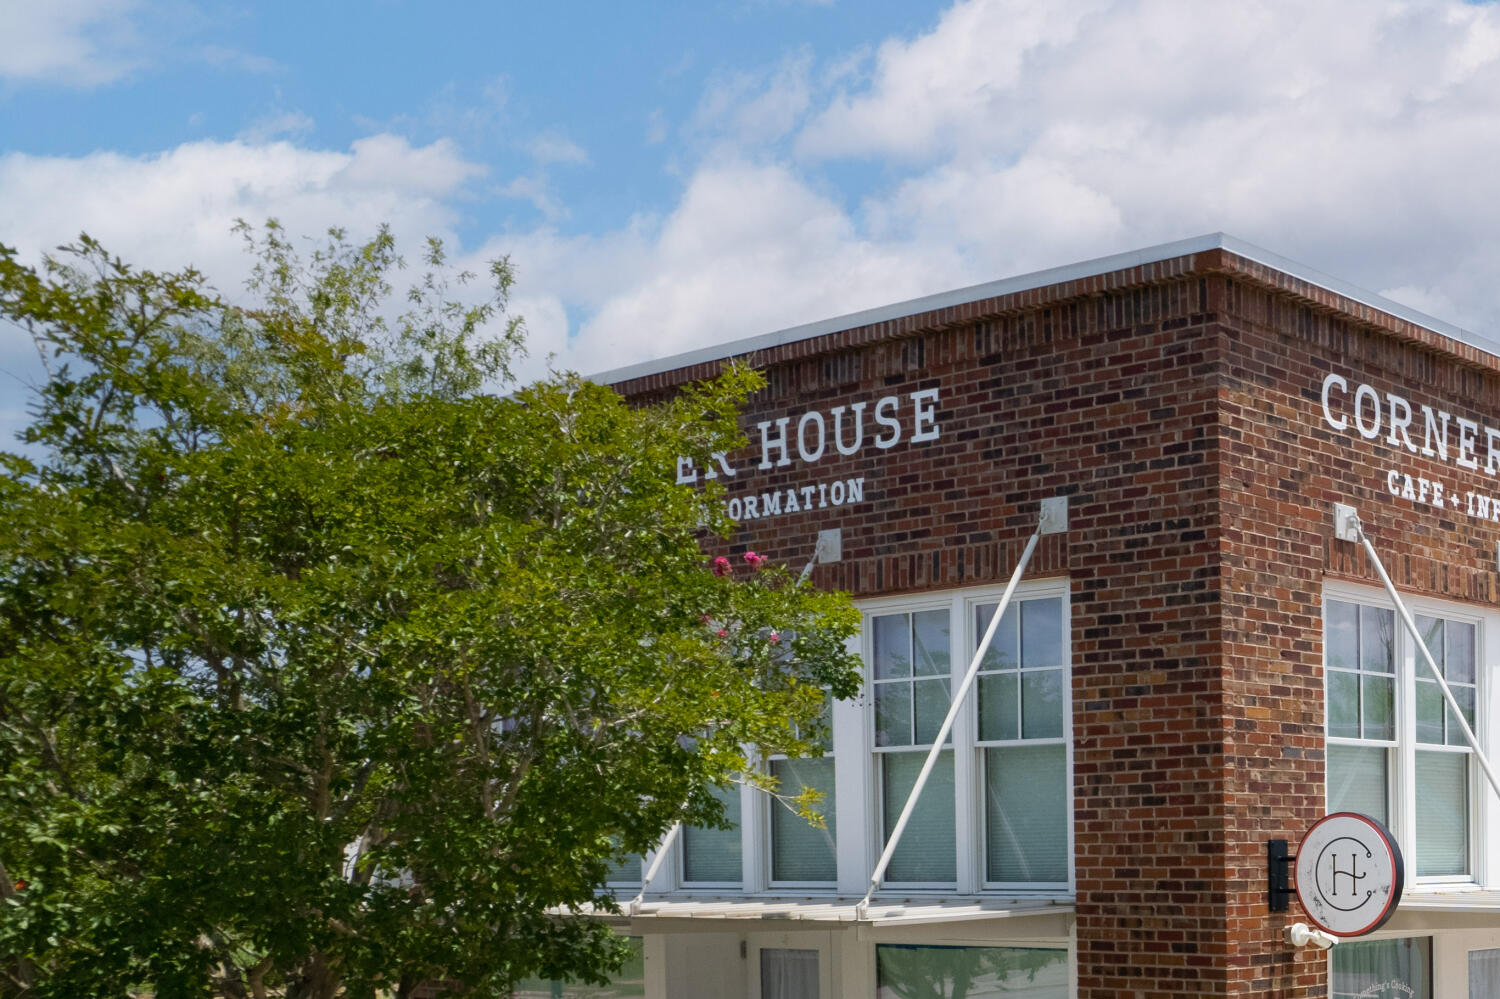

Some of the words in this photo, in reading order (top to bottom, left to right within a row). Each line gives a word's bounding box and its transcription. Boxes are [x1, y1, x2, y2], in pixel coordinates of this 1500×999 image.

[757, 388, 940, 470] HOUSE
[700, 477, 865, 526] ORMATION
[1387, 470, 1444, 508] CAFE
